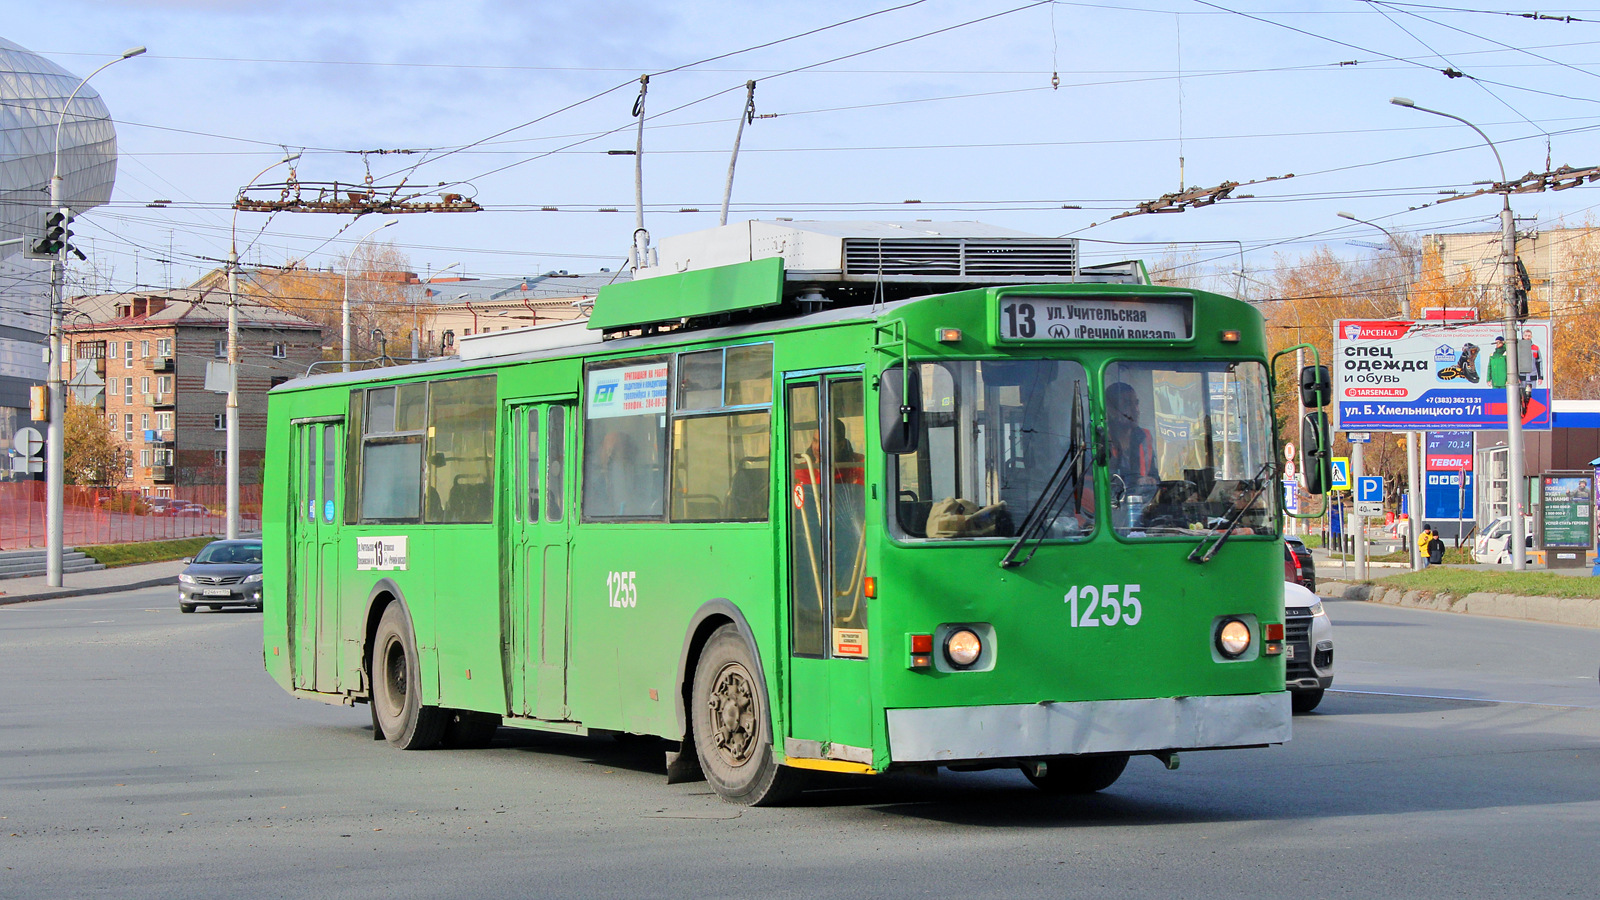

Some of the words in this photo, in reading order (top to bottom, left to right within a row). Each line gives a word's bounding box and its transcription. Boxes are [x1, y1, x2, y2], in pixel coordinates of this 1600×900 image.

[1004, 303, 1036, 338] 13
[1046, 306, 1065, 321] ул.
[1067, 304, 1147, 322] Учительская
[1344, 346, 1393, 359] спец
[1344, 360, 1429, 372] одежда
[1357, 373, 1400, 384] обувь
[1345, 406, 1361, 417] ул.
[1364, 405, 1375, 415] Б.
[1377, 405, 1463, 416] Хмельницкого
[1465, 405, 1482, 416] 1/1
[1447, 440, 1470, 449] 70,14
[375, 540, 383, 566] 13
[606, 571, 637, 608] 1255
[1063, 584, 1142, 628] 1255
